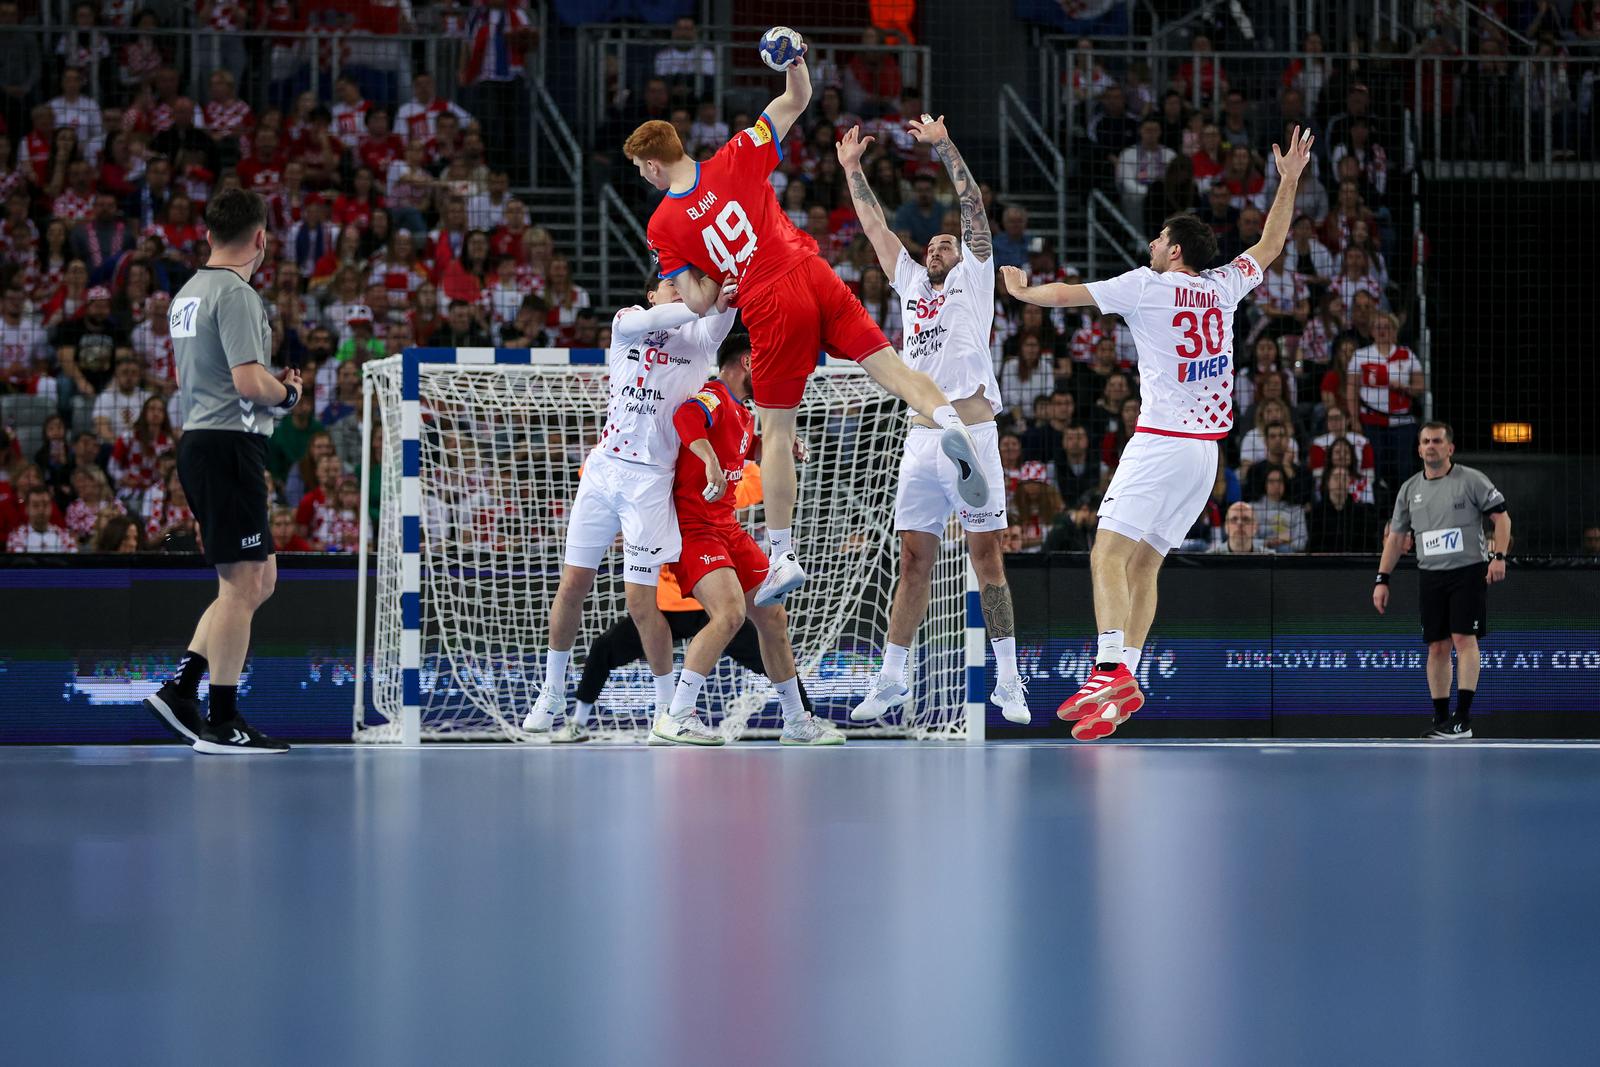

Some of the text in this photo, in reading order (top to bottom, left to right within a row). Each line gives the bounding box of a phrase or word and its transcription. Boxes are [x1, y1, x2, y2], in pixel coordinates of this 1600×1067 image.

[701, 200, 758, 277] 49
[183, 300, 198, 331] TV
[1172, 307, 1224, 359] 30
[669, 356, 692, 366] triglav
[241, 532, 262, 549] EHF
[1441, 530, 1460, 550] TV
[1226, 650, 1348, 668] DISCOVER
[1355, 650, 1422, 668] YOUR
[1512, 650, 1544, 669] AT
